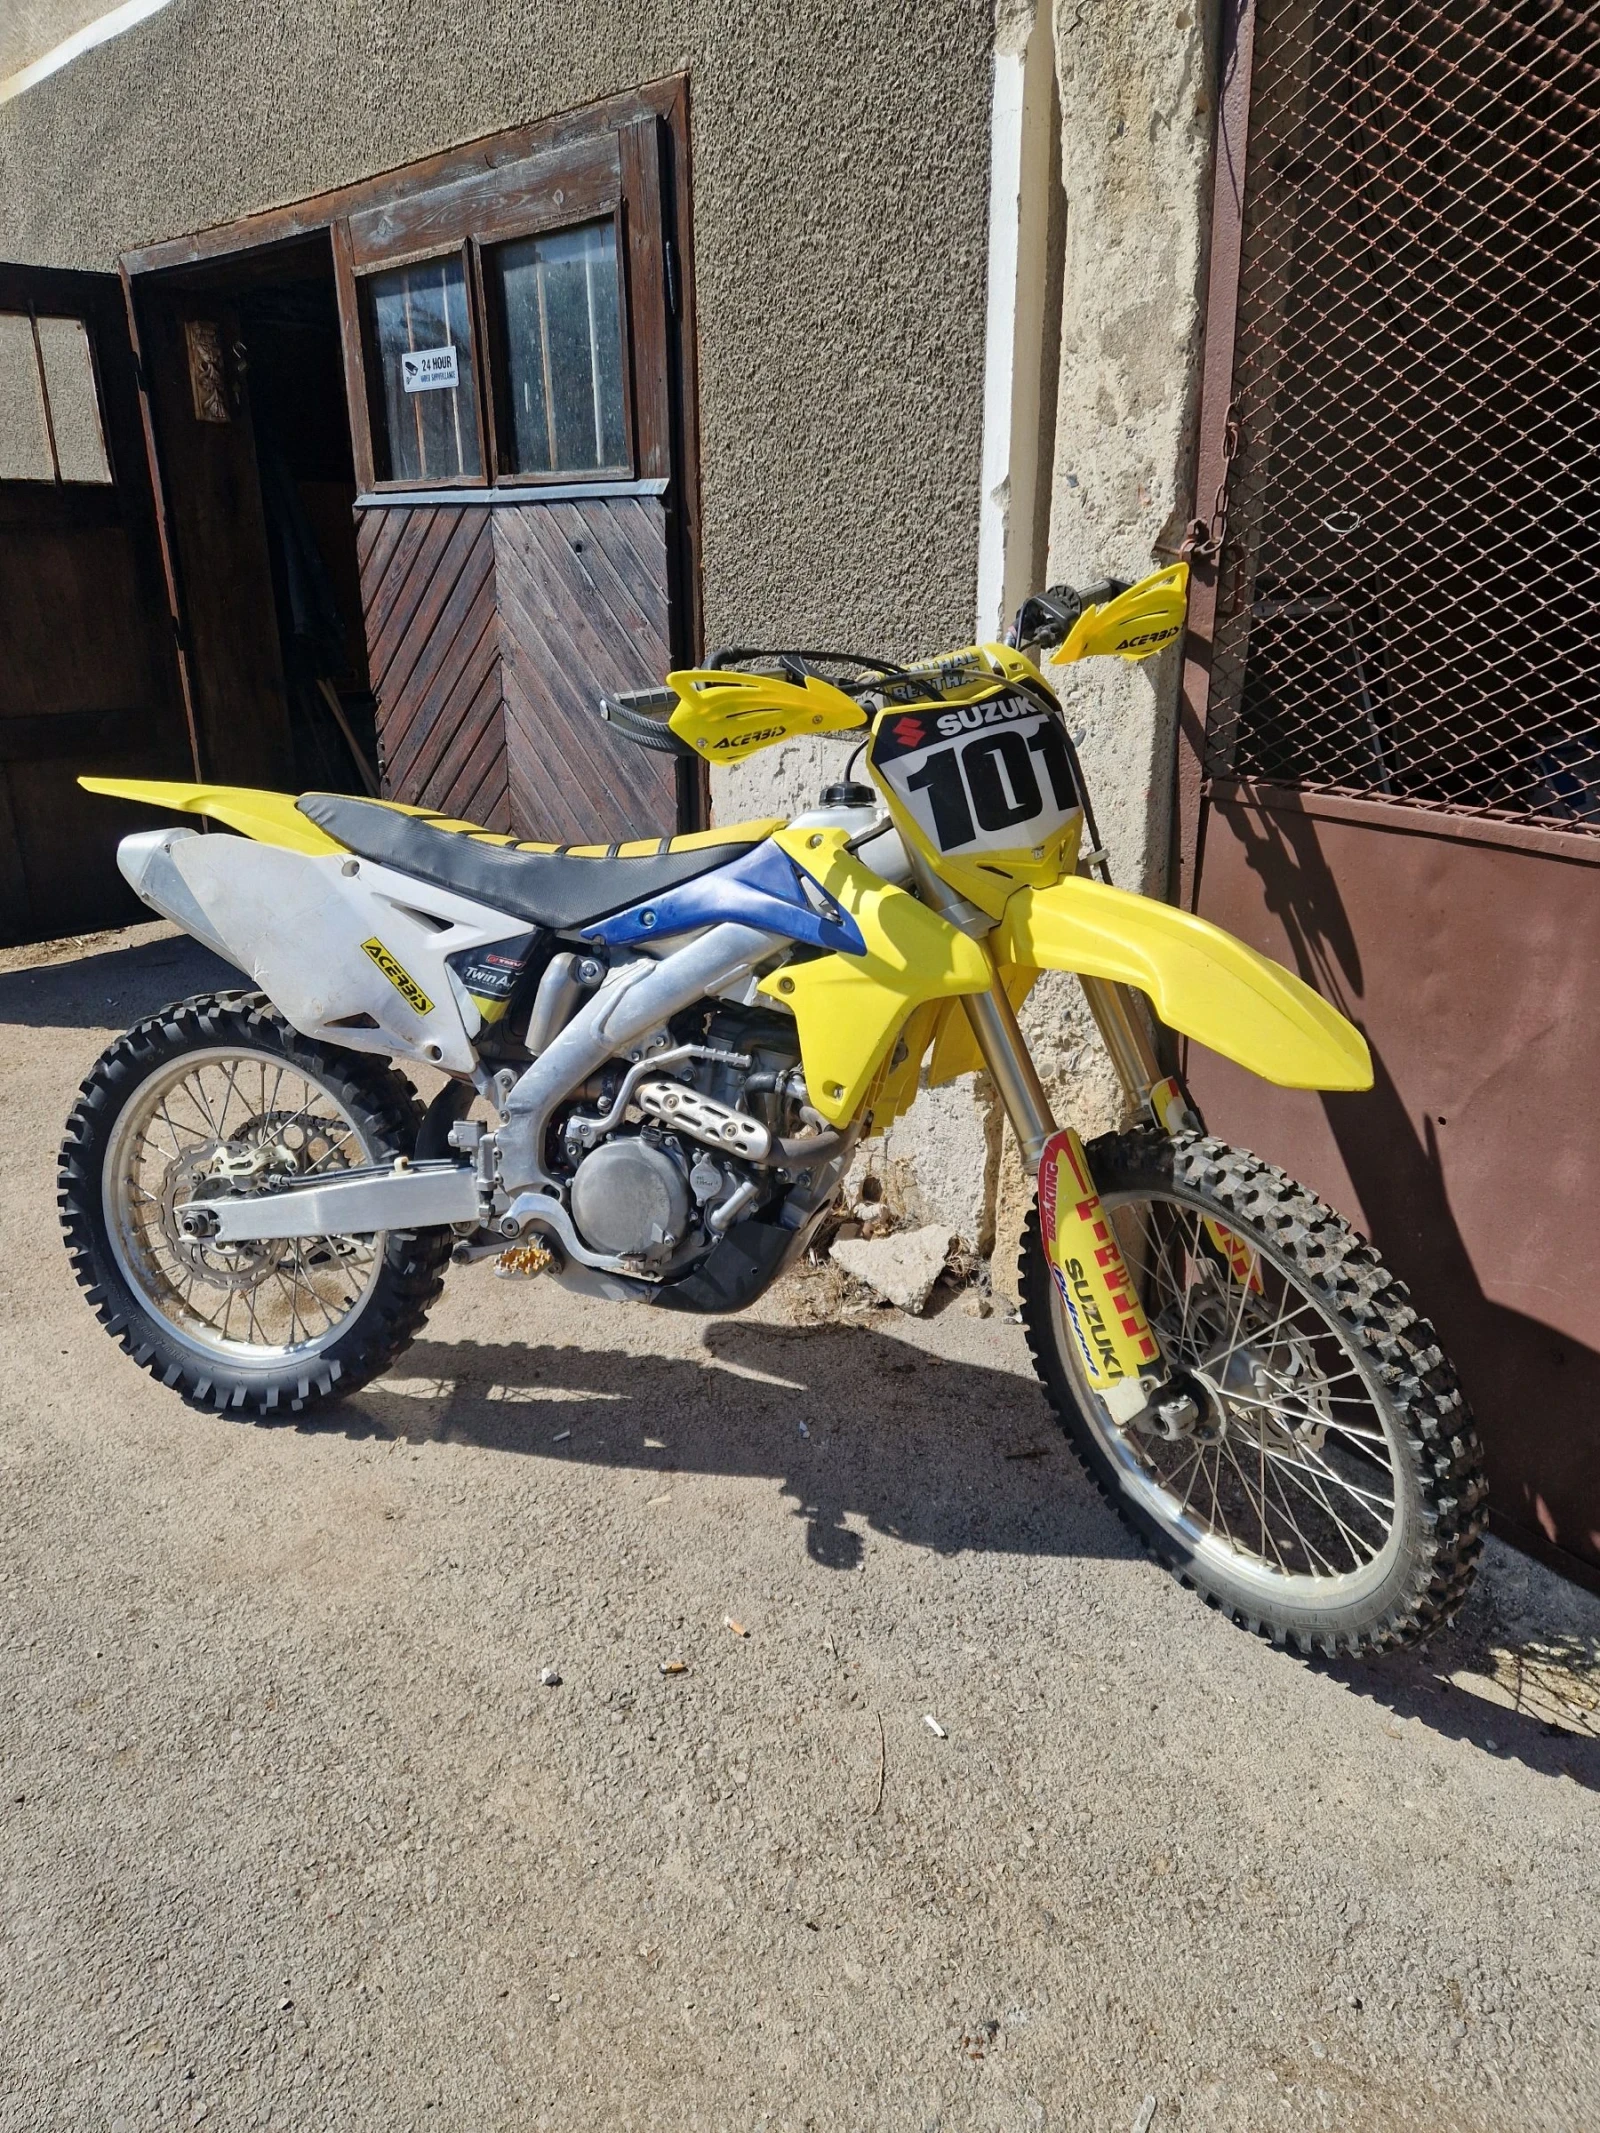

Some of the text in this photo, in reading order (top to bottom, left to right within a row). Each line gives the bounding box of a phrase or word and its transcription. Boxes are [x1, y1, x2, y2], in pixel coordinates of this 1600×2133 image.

[421, 355, 452, 371] 24 HOUR
[936, 693, 1040, 736] SUZUK
[906, 720, 1080, 852] 101
[465, 966, 498, 984] Twin
[1043, 1160, 1059, 1242] BRAKING
[1075, 1195, 1155, 1358] PIRELLI
[1065, 1258, 1125, 1379] SUZUKI
